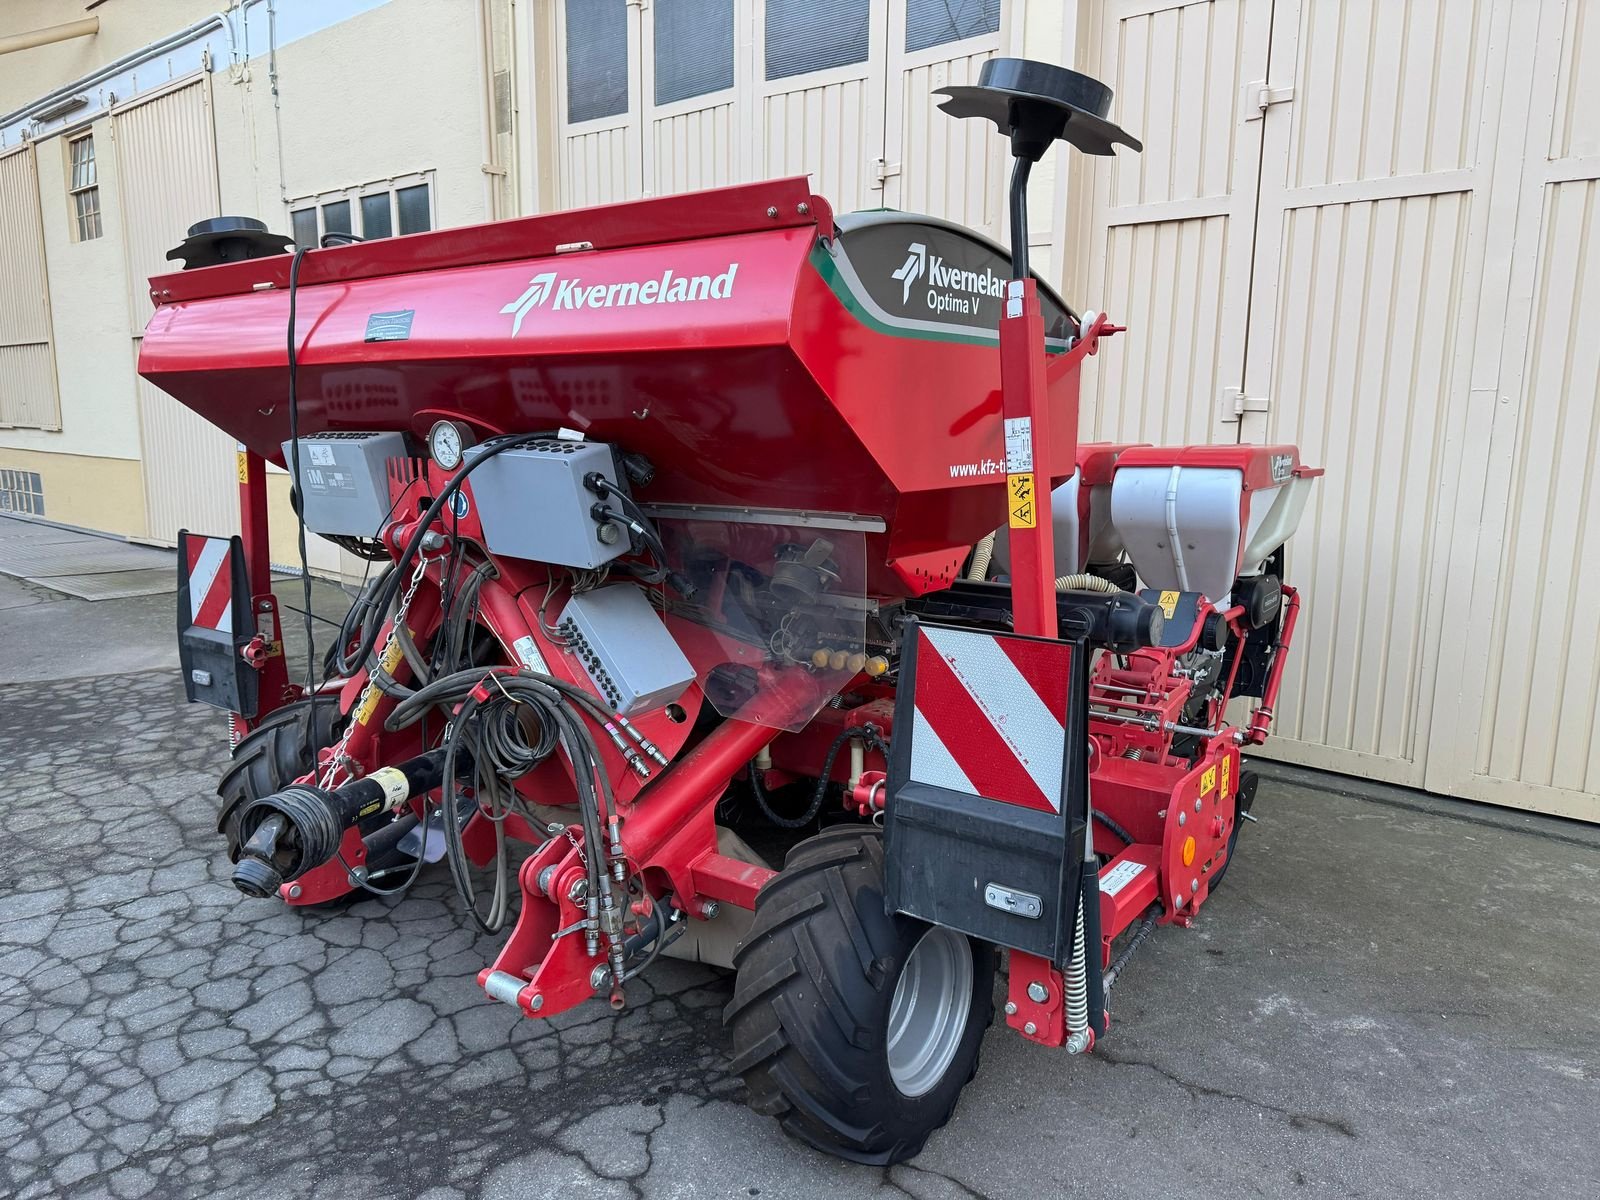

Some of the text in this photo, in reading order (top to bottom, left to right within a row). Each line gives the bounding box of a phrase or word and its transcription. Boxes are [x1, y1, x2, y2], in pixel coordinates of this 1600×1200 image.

[551, 263, 739, 311] Kverneland
[928, 255, 1006, 299] Kvernelan
[927, 289, 980, 316] Optima V
[949, 457, 1006, 478] www.kfz-ti
